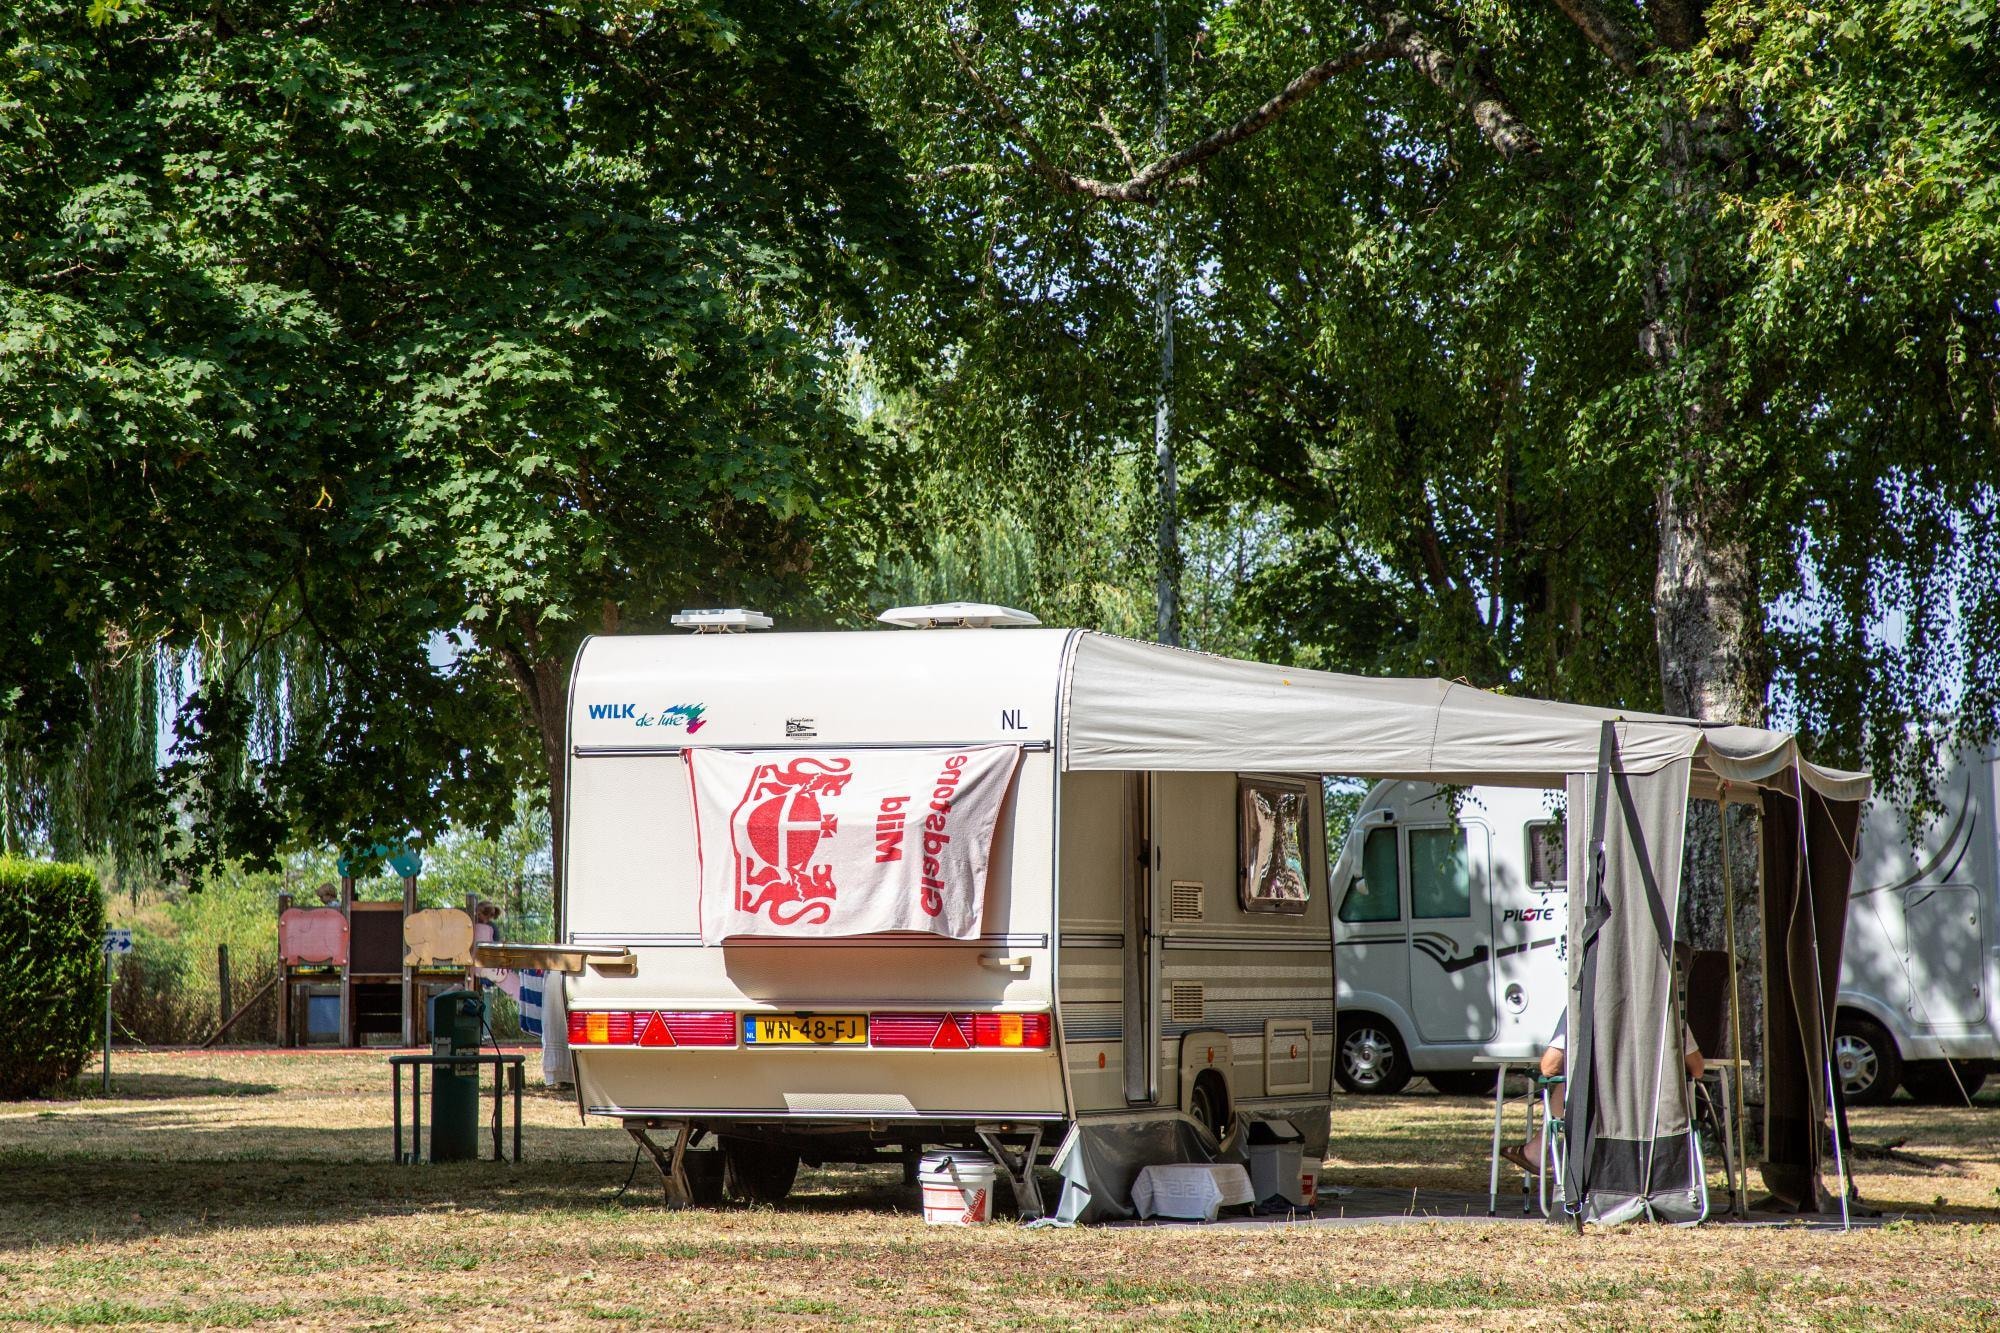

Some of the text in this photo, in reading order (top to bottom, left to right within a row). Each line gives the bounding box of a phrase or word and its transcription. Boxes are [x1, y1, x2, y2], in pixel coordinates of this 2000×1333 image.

[588, 703, 636, 720] WILK
[635, 712, 655, 727] de
[1002, 709, 1028, 730] NL
[1503, 908, 1555, 922] PILOTE
[763, 1020, 857, 1040] WN-48-FJ
